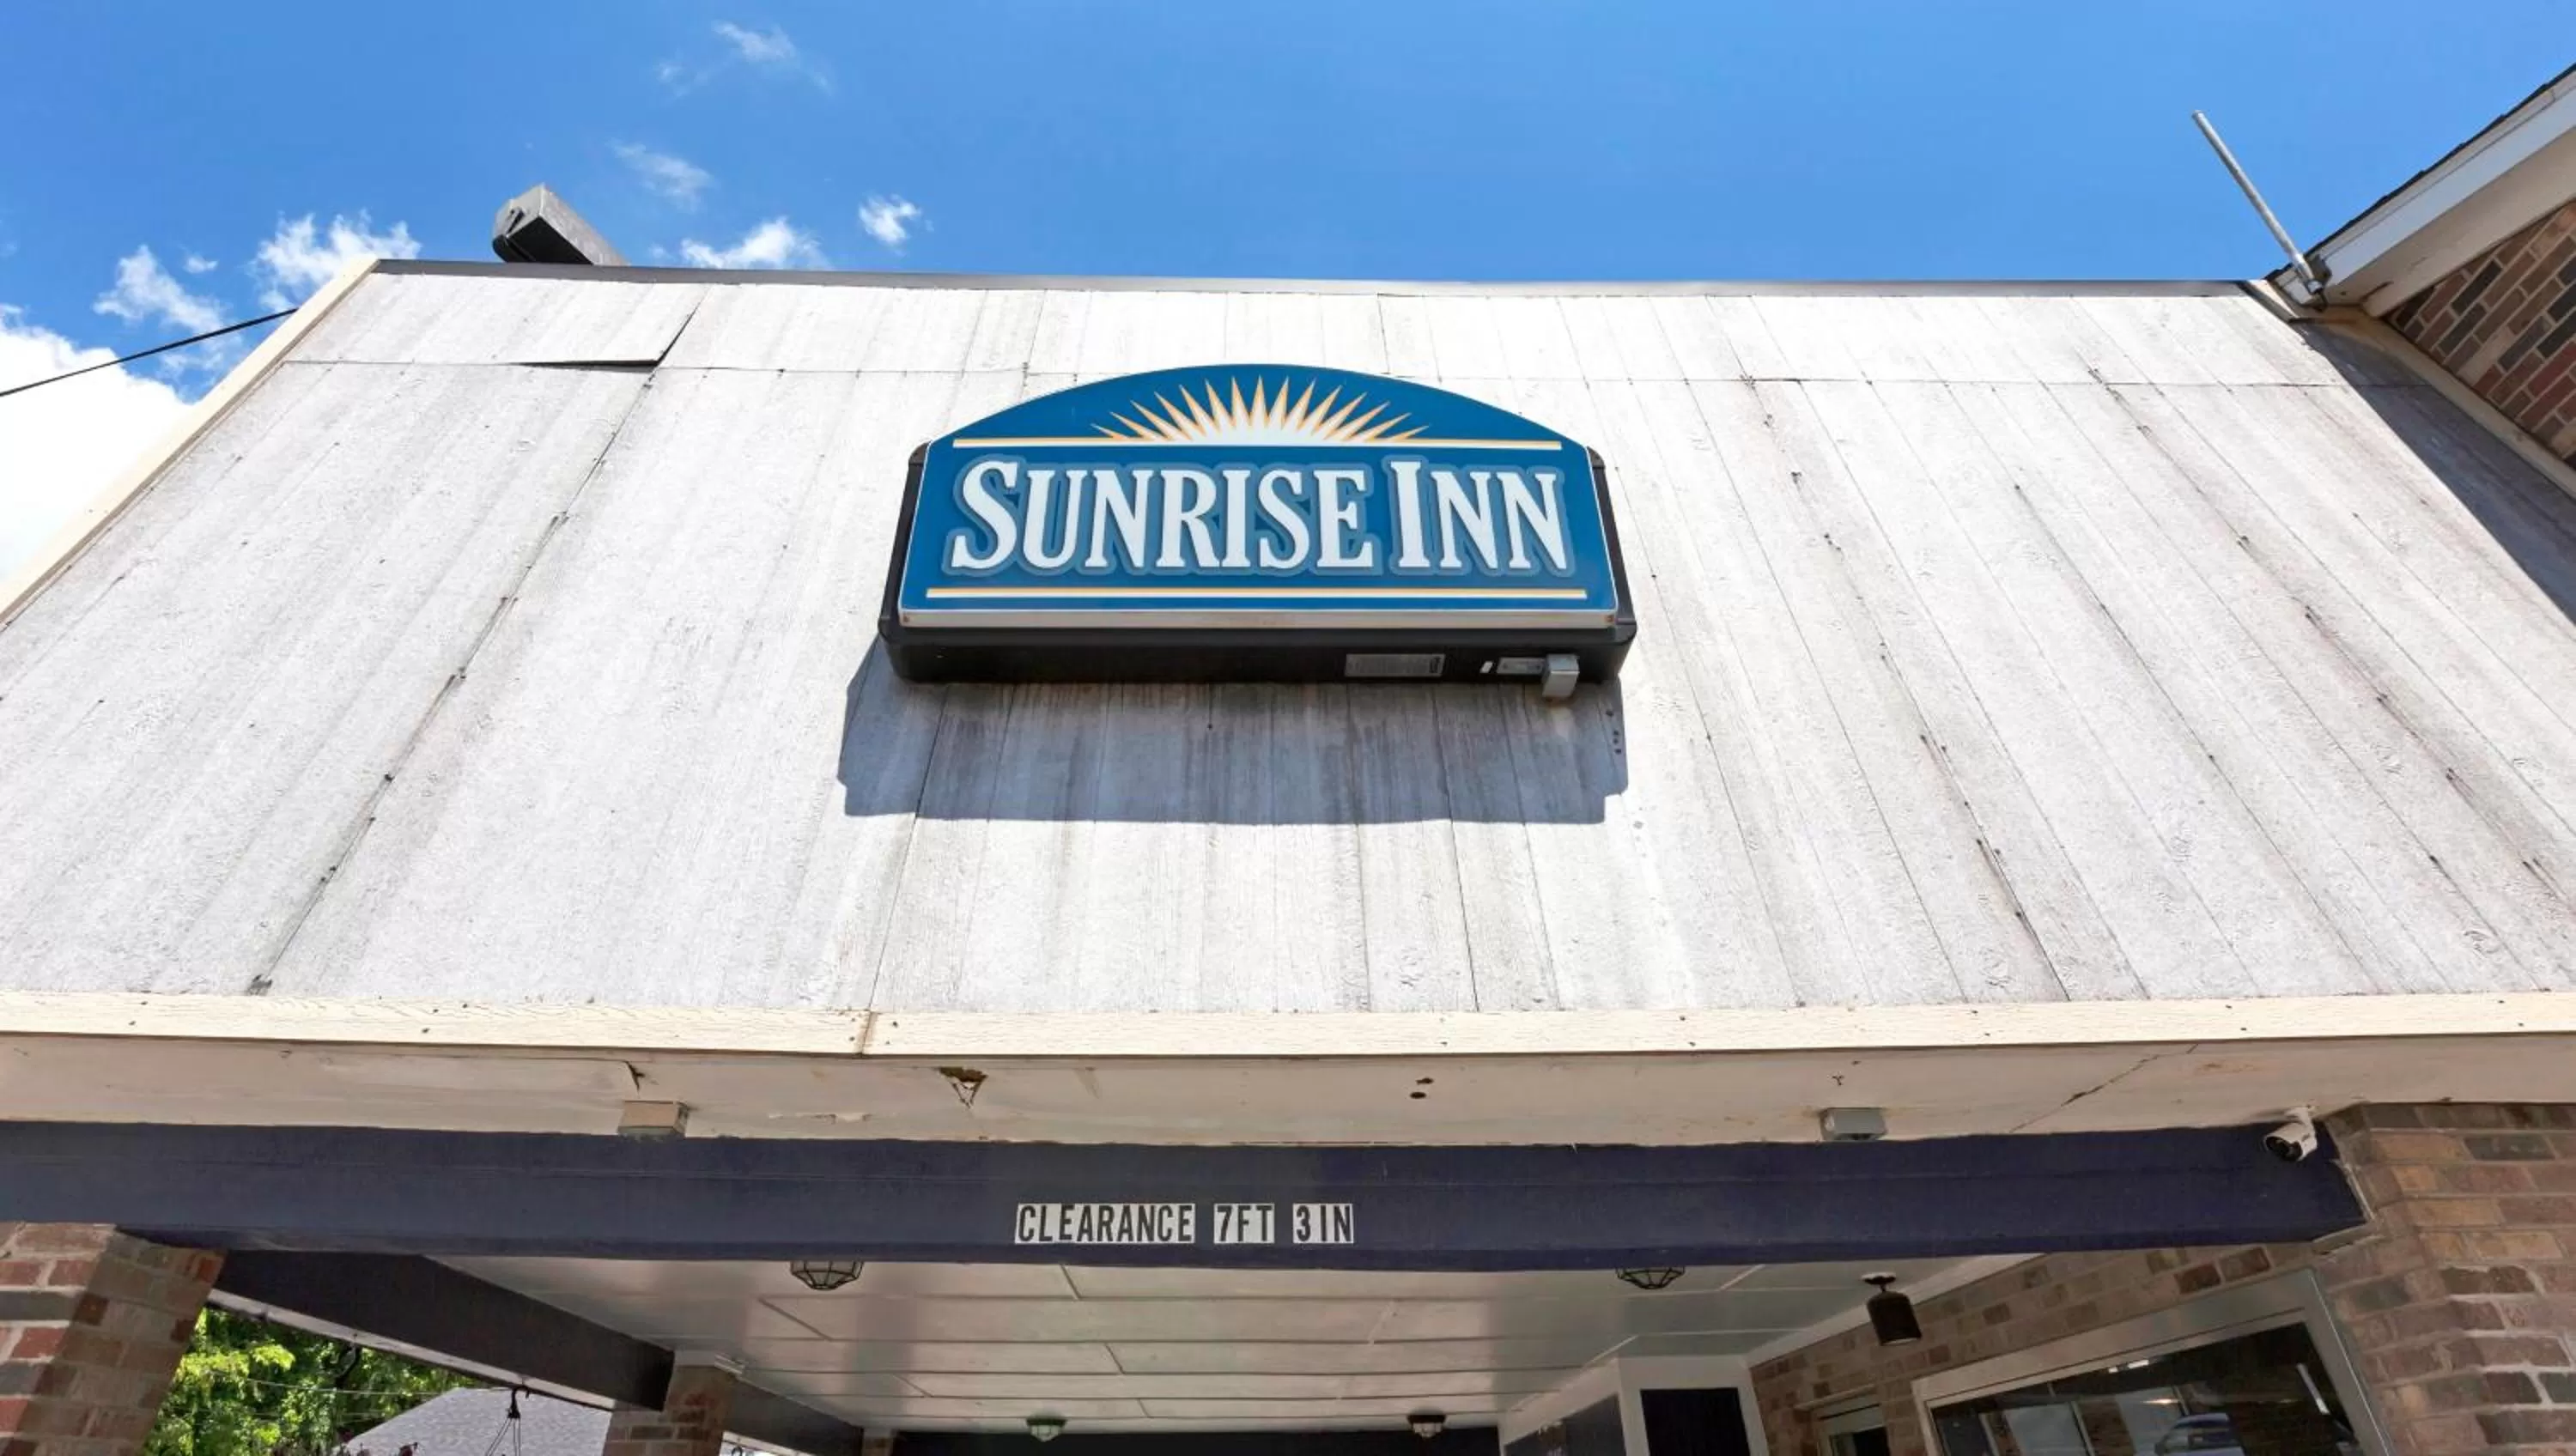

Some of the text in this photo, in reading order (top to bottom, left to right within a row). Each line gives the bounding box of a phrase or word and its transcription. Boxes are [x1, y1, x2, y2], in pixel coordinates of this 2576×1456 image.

[951, 459, 1569, 571] SUNRISE INN
[1018, 1204, 1352, 1242] CLEARANCE 7FT 3IN
